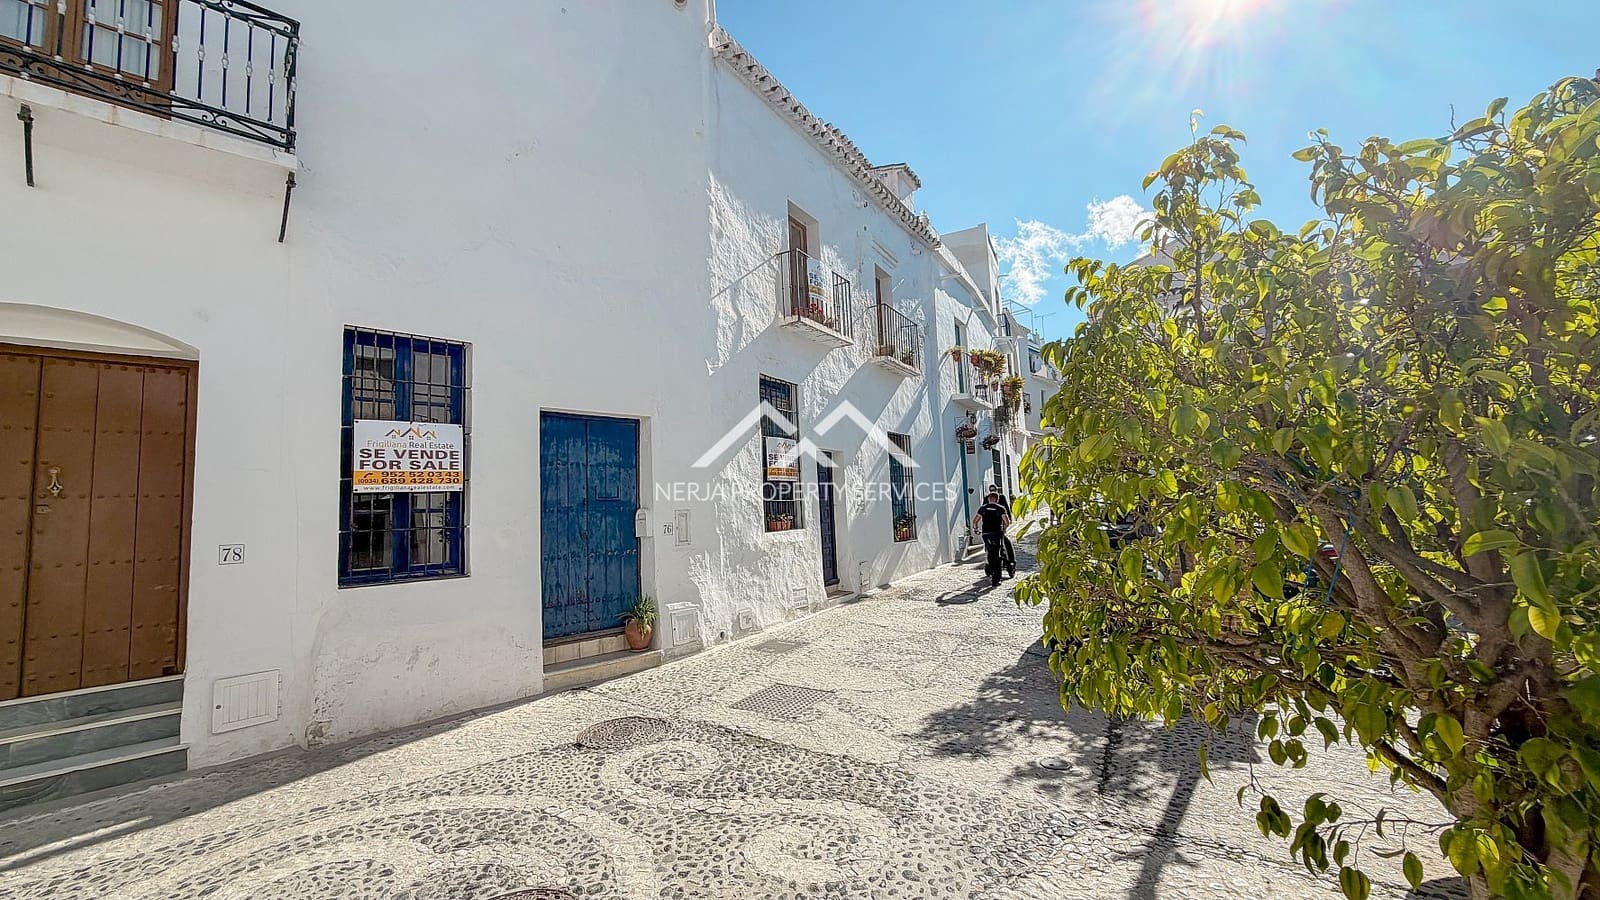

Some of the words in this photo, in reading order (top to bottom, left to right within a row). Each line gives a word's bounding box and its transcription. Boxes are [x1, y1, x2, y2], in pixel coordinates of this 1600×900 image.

[367, 440, 407, 449] Frigiliana
[429, 442, 454, 450] Estate
[359, 449, 386, 459] SE
[393, 449, 460, 460] VENDE
[359, 460, 402, 470] FOR
[409, 460, 460, 470] SALE
[381, 477, 406, 485] 689
[663, 524, 672, 534] 76
[222, 547, 242, 562] 78
